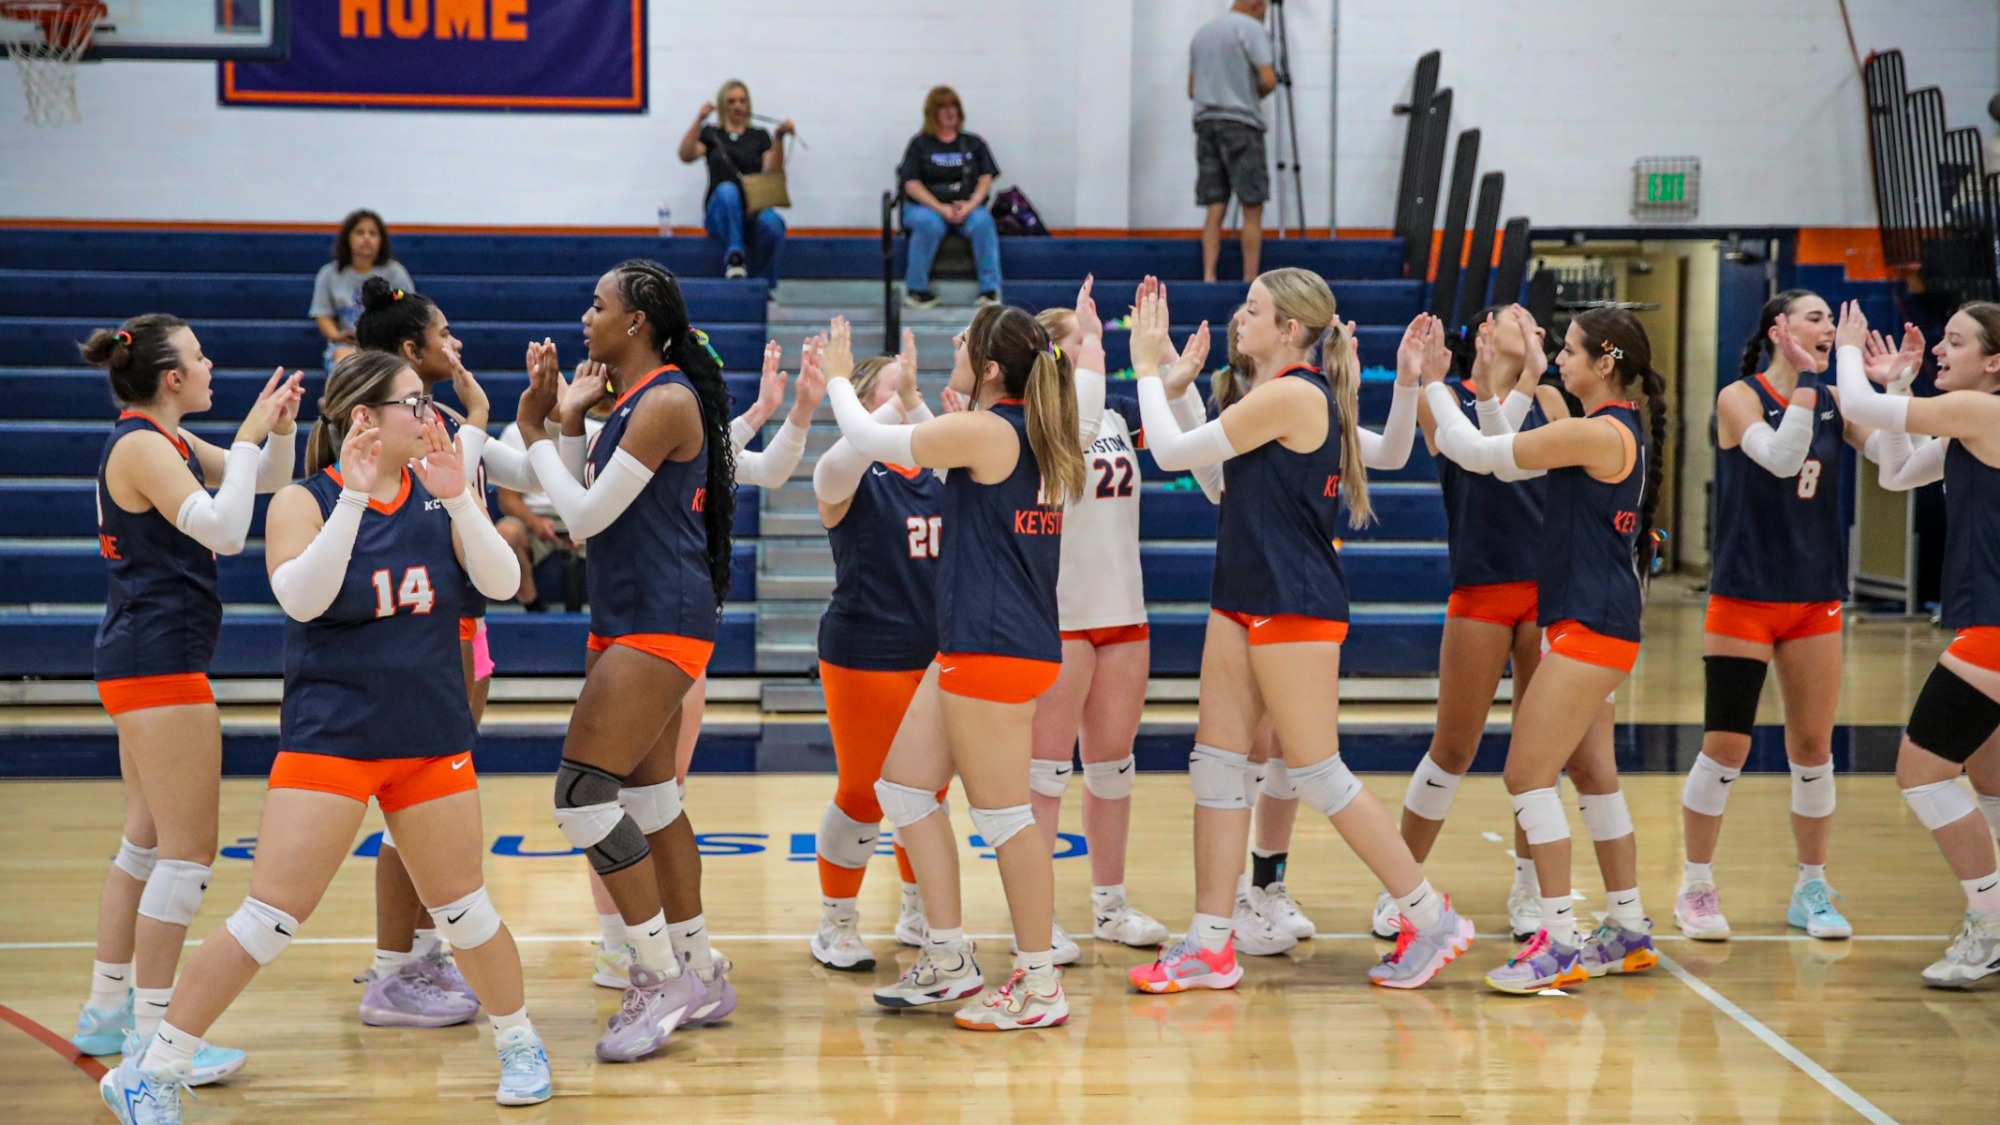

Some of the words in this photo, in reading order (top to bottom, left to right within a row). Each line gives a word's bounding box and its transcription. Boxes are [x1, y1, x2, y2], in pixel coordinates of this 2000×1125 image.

[1648, 173, 1684, 201] EXIT
[1093, 456, 1133, 499] 22
[1798, 460, 1821, 498] 8
[424, 499, 441, 511] KC
[371, 565, 435, 618] 14
